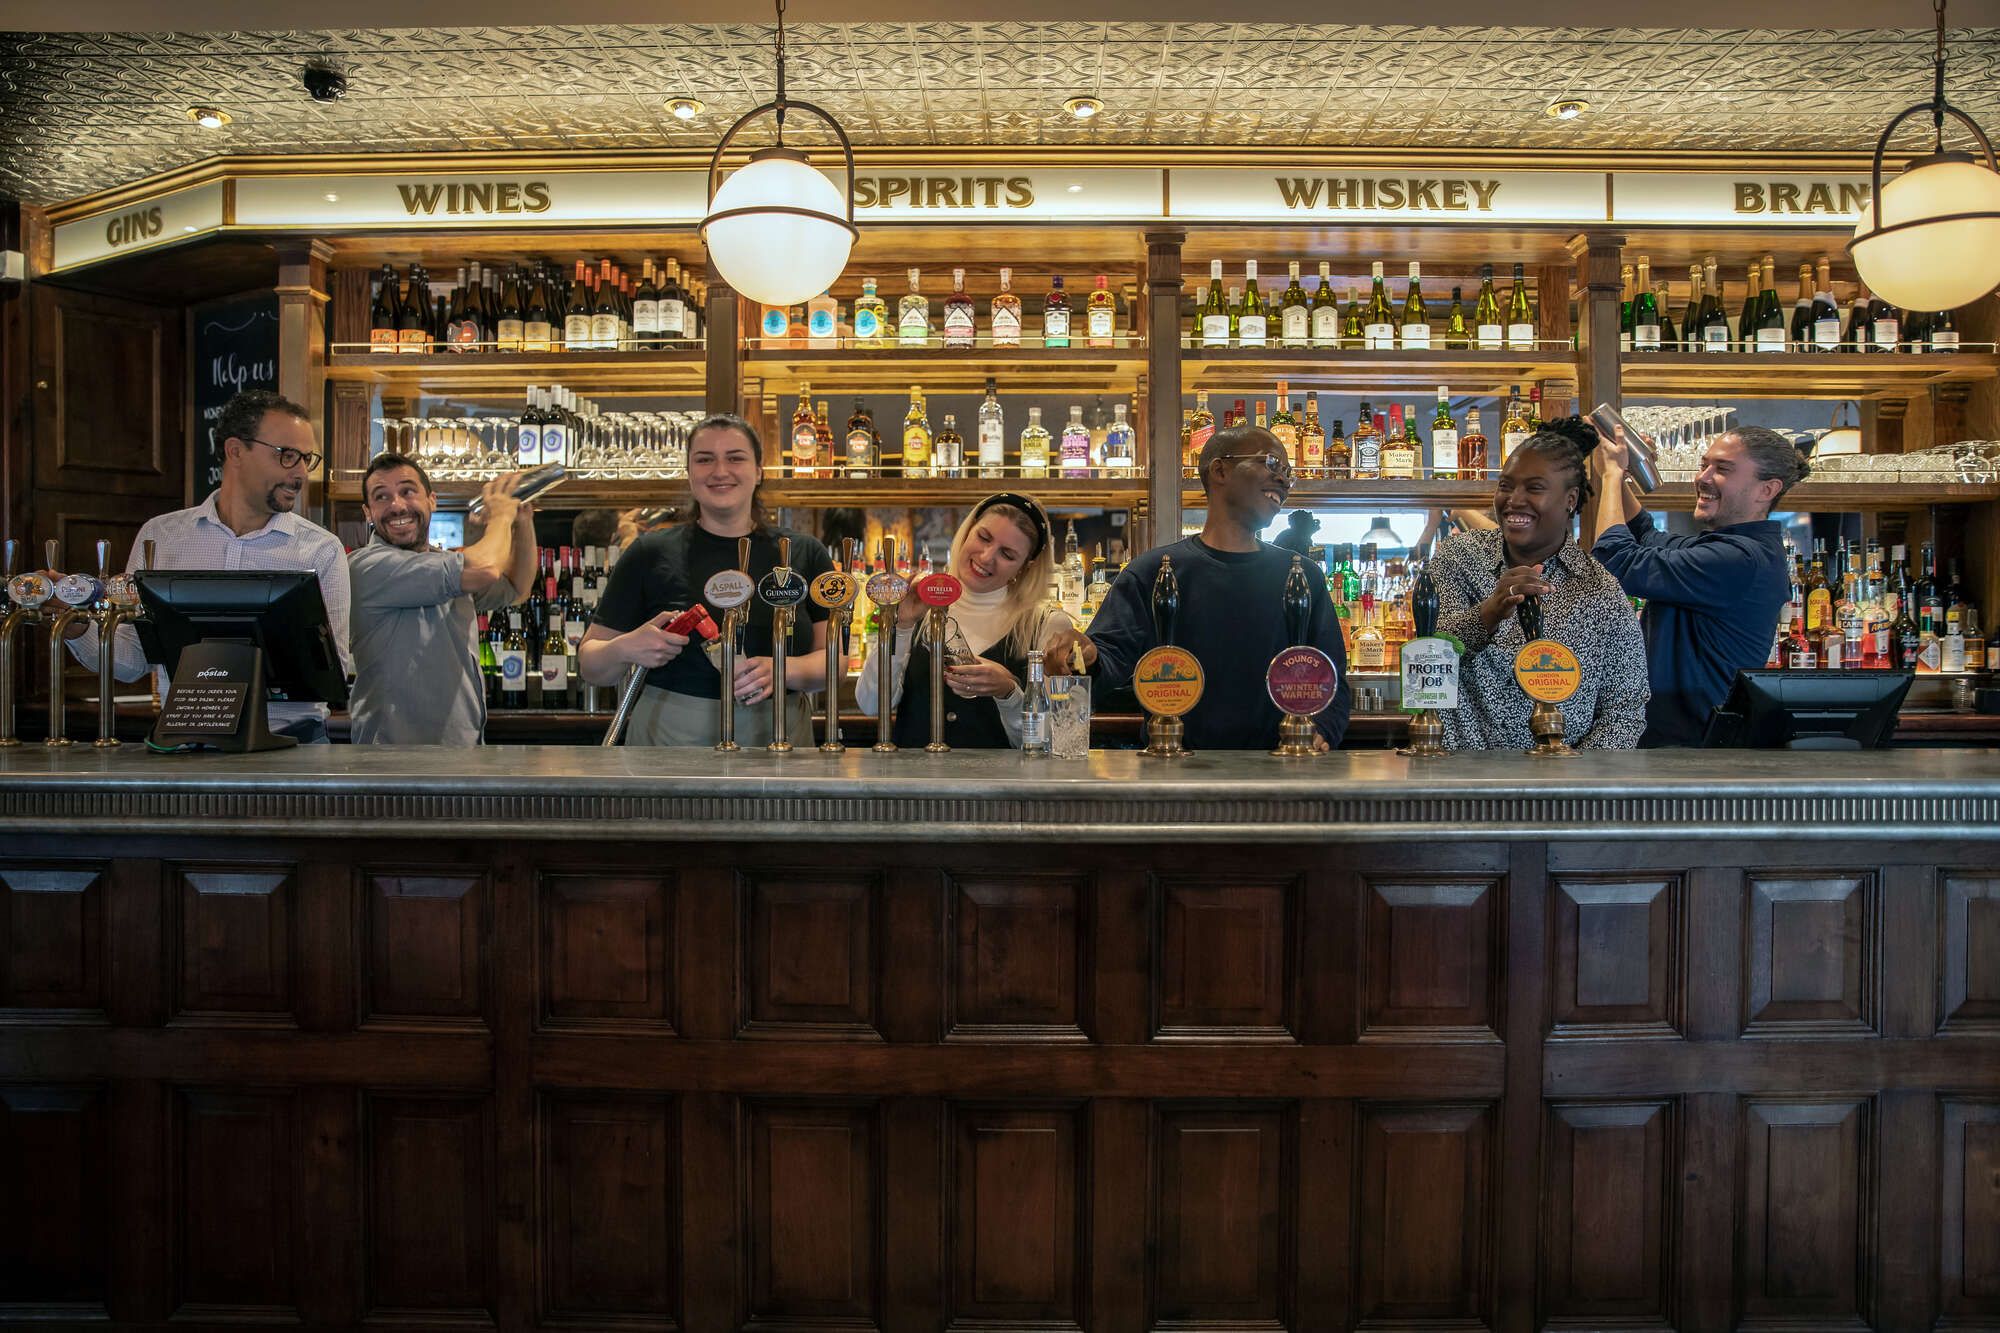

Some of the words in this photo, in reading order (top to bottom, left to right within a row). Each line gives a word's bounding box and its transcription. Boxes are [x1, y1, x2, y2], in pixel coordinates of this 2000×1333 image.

[396, 182, 552, 215] WINES
[853, 176, 1035, 209] SPIRITS
[1275, 178, 1501, 211] WHISKEY
[1734, 182, 1884, 214] BRAN
[106, 206, 163, 247] GINS
[711, 581, 744, 592] ASPALL
[765, 589, 800, 597] GUINNESS
[1282, 655, 1320, 668] YOUNG'S
[1408, 663, 1453, 674] PROPER
[1421, 676, 1443, 688] JOB
[1528, 678, 1572, 686] ORIGINAL
[1146, 689, 1192, 698] ORIGINAL
[1280, 690, 1323, 699] WARMER
